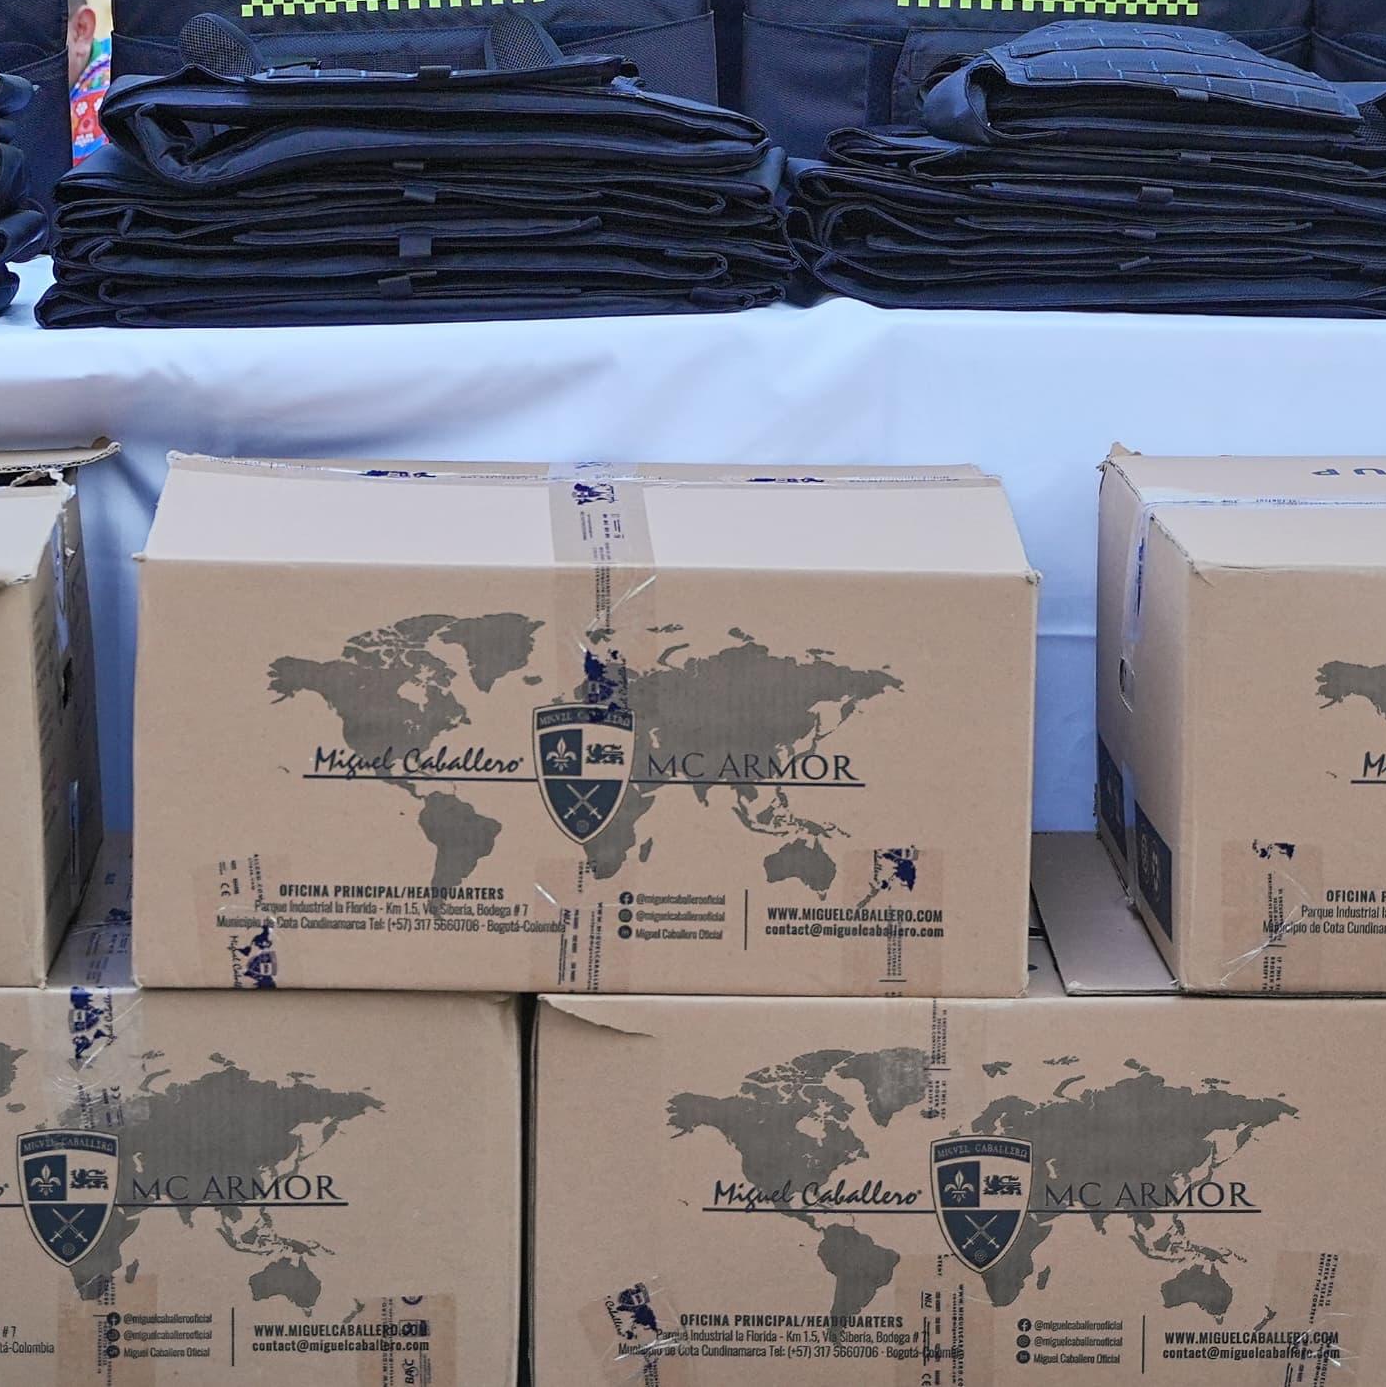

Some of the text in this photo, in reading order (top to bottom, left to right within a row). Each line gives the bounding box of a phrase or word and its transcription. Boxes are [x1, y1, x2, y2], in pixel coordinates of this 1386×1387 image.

[314, 745, 521, 780] Miguel Caballero
[647, 752, 859, 781] MC ARMOR
[279, 883, 504, 901] OFICINA PRINCIPAL/HEADQUARTERS
[1326, 888, 1377, 903] OFICINA
[767, 906, 943, 922] WWW.MIGUELCABALLERO.COM
[131, 1173, 342, 1203] MC ARMOR
[713, 1177, 919, 1214] Miguel Caballero
[1044, 1180, 1256, 1210] MC ARMOR
[680, 1312, 904, 1331] OFICINA PRINCIPAL/HEADQUARTERS
